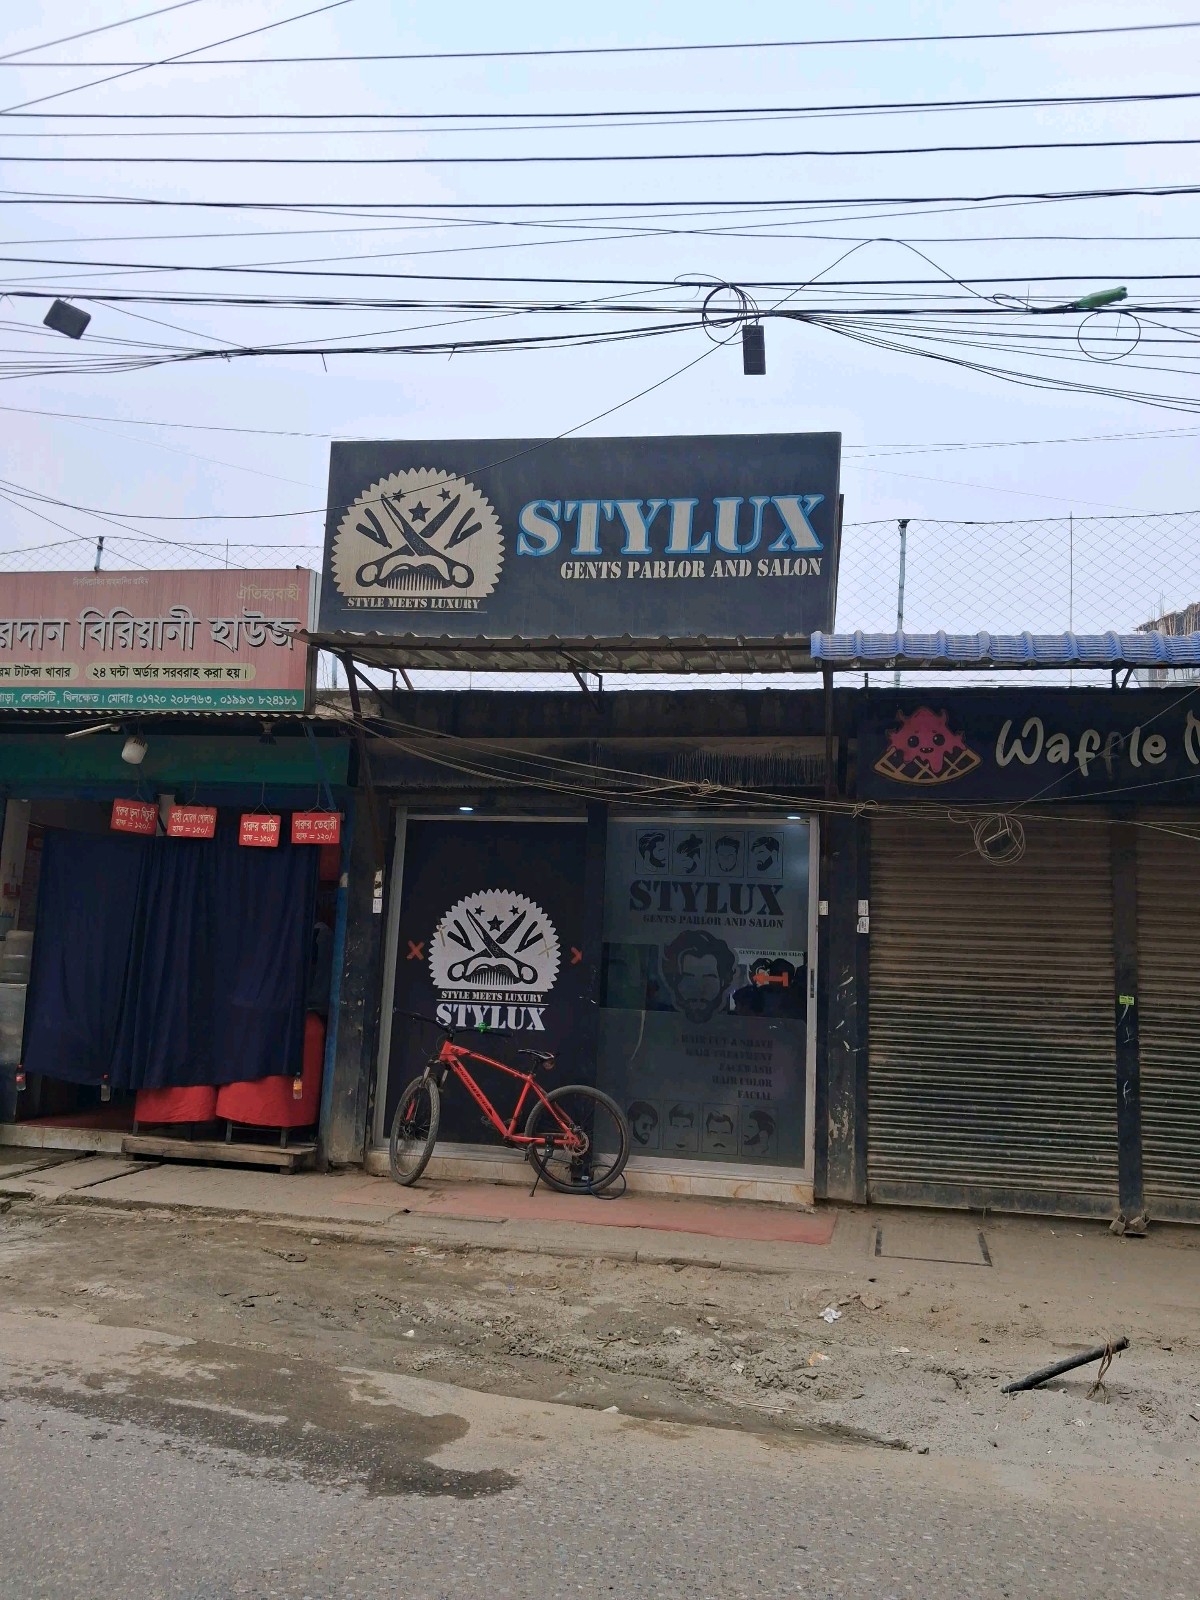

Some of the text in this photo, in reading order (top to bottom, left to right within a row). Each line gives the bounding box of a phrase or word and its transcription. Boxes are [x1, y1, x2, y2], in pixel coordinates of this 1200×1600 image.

[516, 494, 825, 557] STYLUX
[560, 557, 823, 580] GENTS PARLOR AND SALON
[347, 597, 481, 609] STYLE MEETS LUXURY
[77, 604, 202, 652] বিরিয়ানী
[207, 606, 302, 654] হাউজ
[14, 664, 42, 678] টাটকা
[45, 665, 71, 678] খাবার
[92, 667, 106, 679] ২৪
[132, 663, 159, 678] অর্ডার
[163, 667, 200, 679] সরবরাহ
[203, 667, 223, 679] করা
[136, 695, 167, 705] ০১৭২০
[258, 696, 298, 706] ৮২৪১৮১
[243, 821, 259, 832] গরুর
[295, 816, 337, 830] গরুর তেহারী
[629, 879, 785, 917] STYLUX
[643, 914, 785, 929] GENTS PARLOR AND SALON
[441, 990, 544, 1003] STYLE MEETS LUXURY
[435, 1003, 546, 1031] STYLUX
[739, 1077, 773, 1088] COLOR
